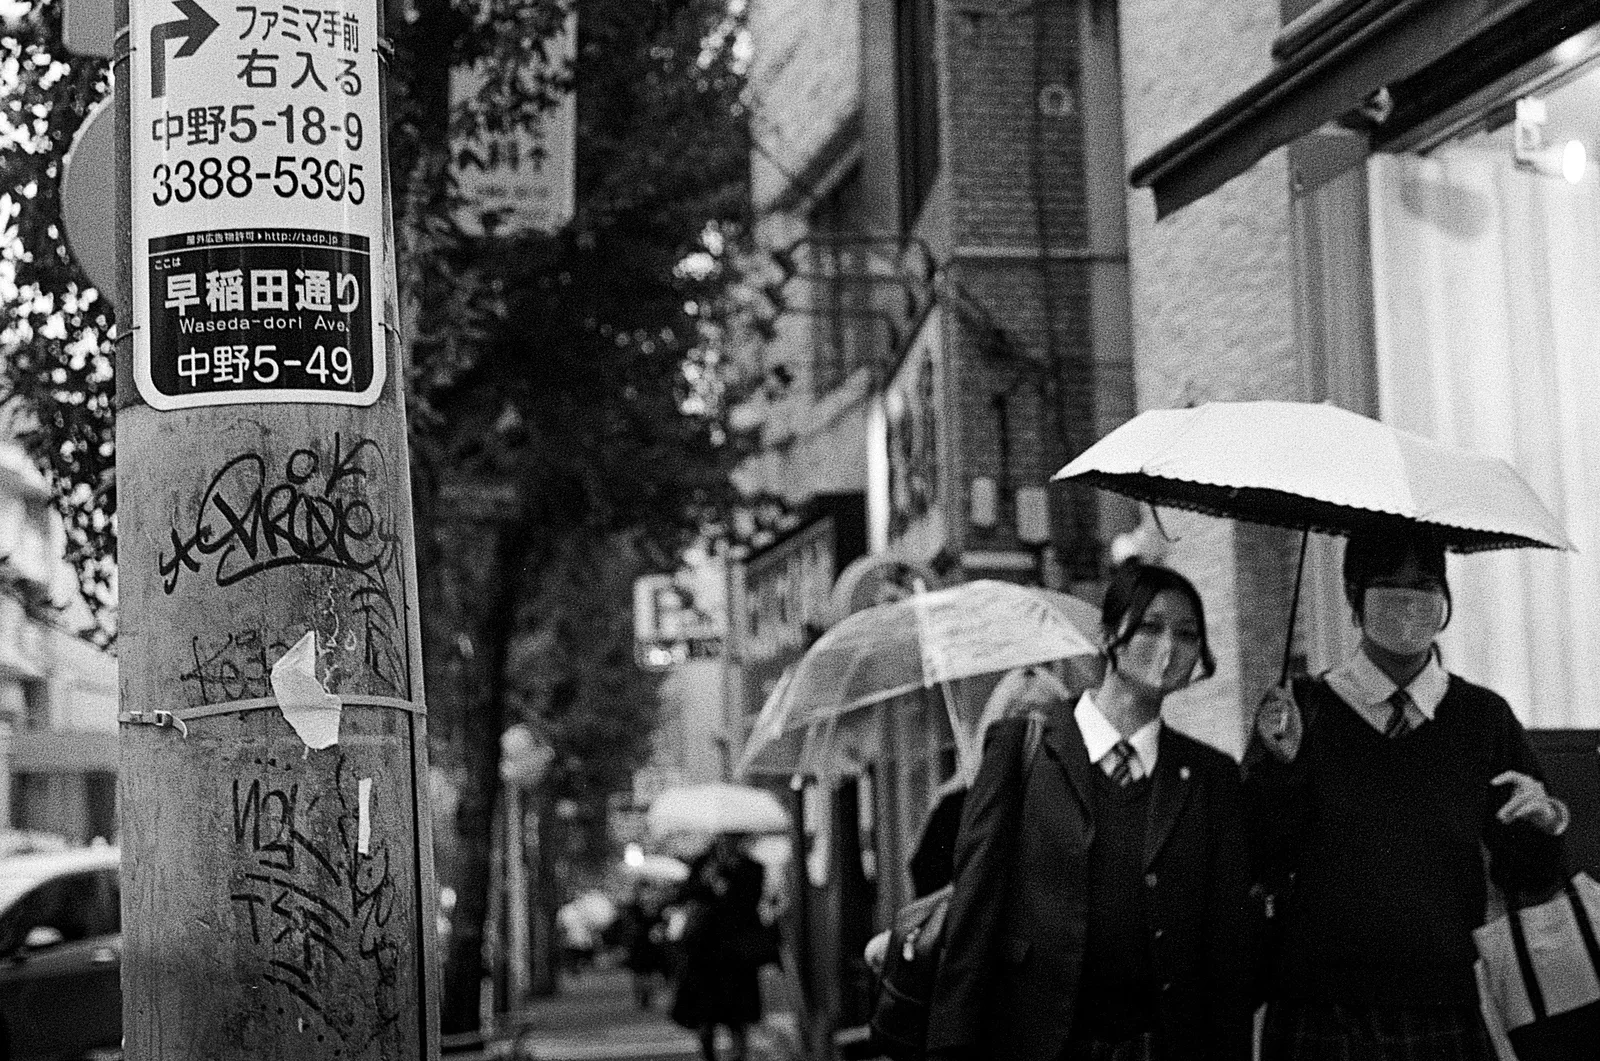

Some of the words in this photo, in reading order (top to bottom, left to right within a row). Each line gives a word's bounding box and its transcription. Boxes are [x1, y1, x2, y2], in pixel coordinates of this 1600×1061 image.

[236, 5, 359, 53] ファミマ手前
[236, 48, 362, 96] 右入る
[152, 104, 363, 151] 中野5-18-9
[152, 156, 365, 206] 3388-5395
[154, 257, 181, 270] ここは
[164, 268, 360, 317] 早稲田通り
[179, 316, 302, 334] Waseda-dori
[314, 315, 350, 332] Ave.
[177, 345, 352, 387] 中野5-49
